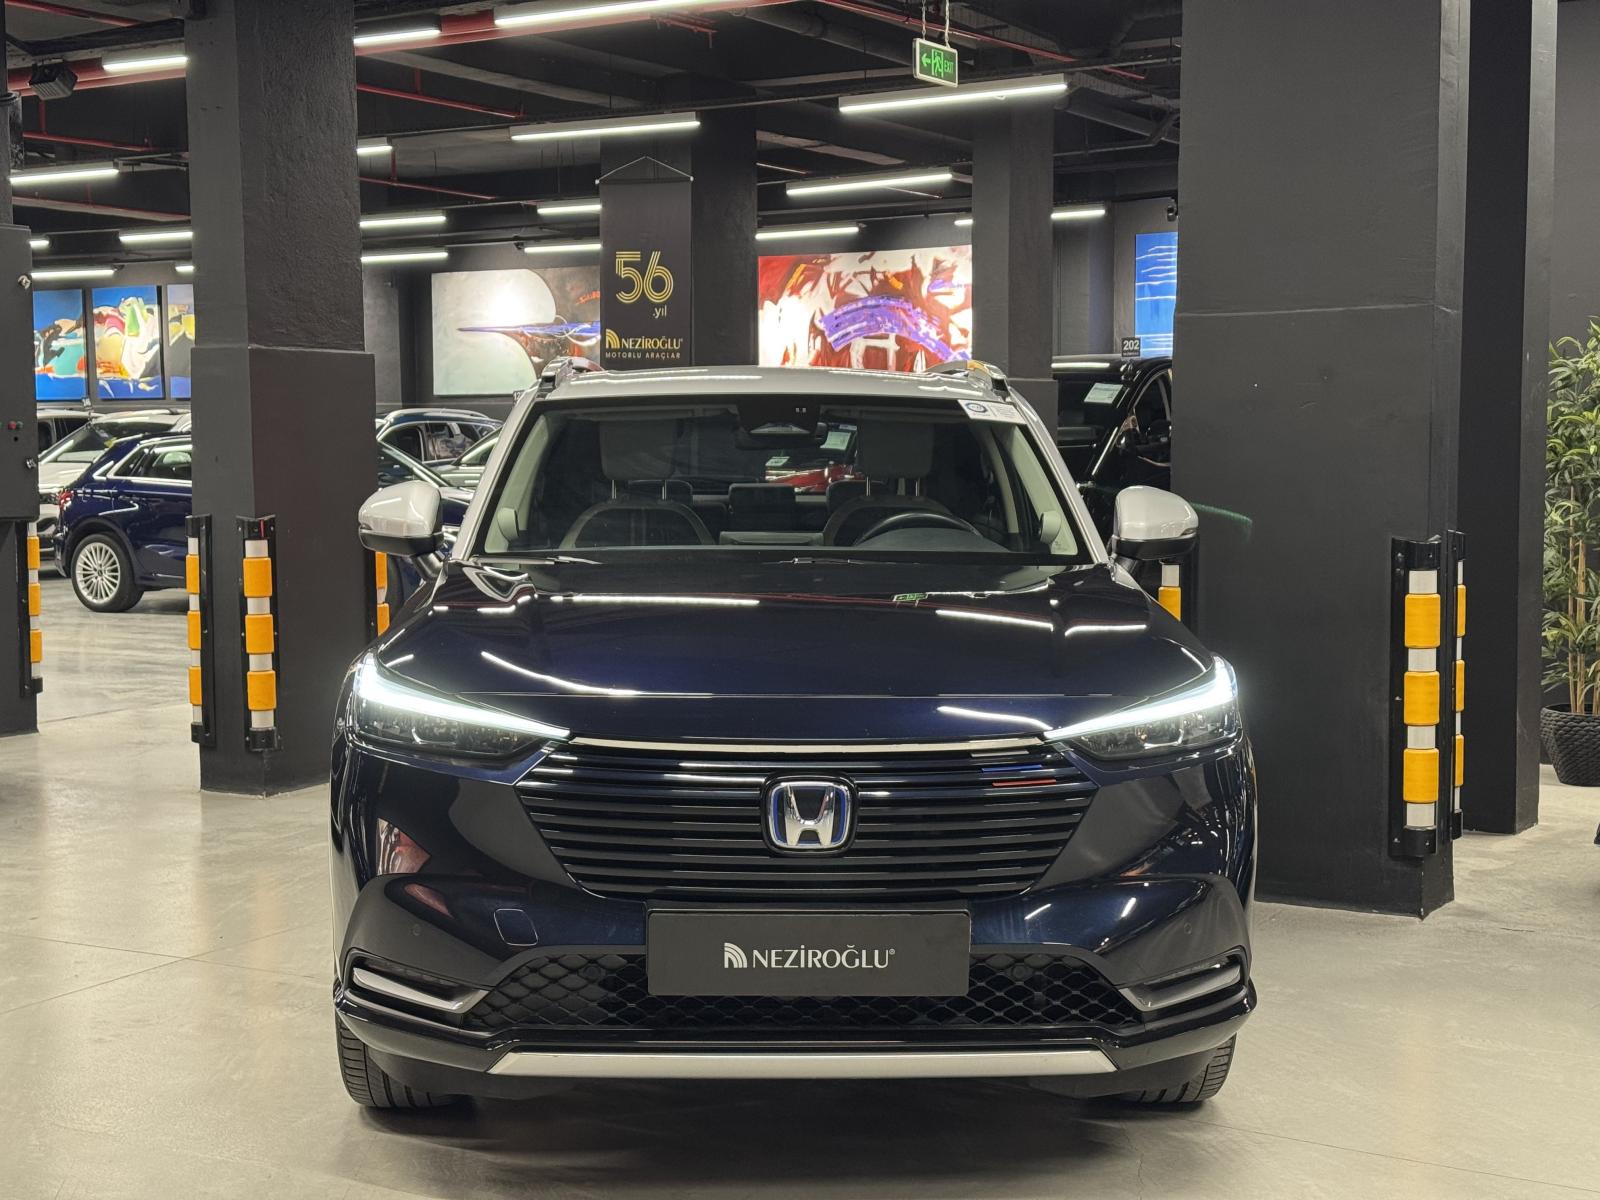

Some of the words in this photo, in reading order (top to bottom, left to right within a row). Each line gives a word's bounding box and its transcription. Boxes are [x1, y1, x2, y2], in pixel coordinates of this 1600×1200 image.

[616, 251, 674, 303] 56
[1123, 340, 1139, 350] 202
[605, 351, 642, 359] MOTORLU
[645, 352, 681, 361] ARAÇLAR
